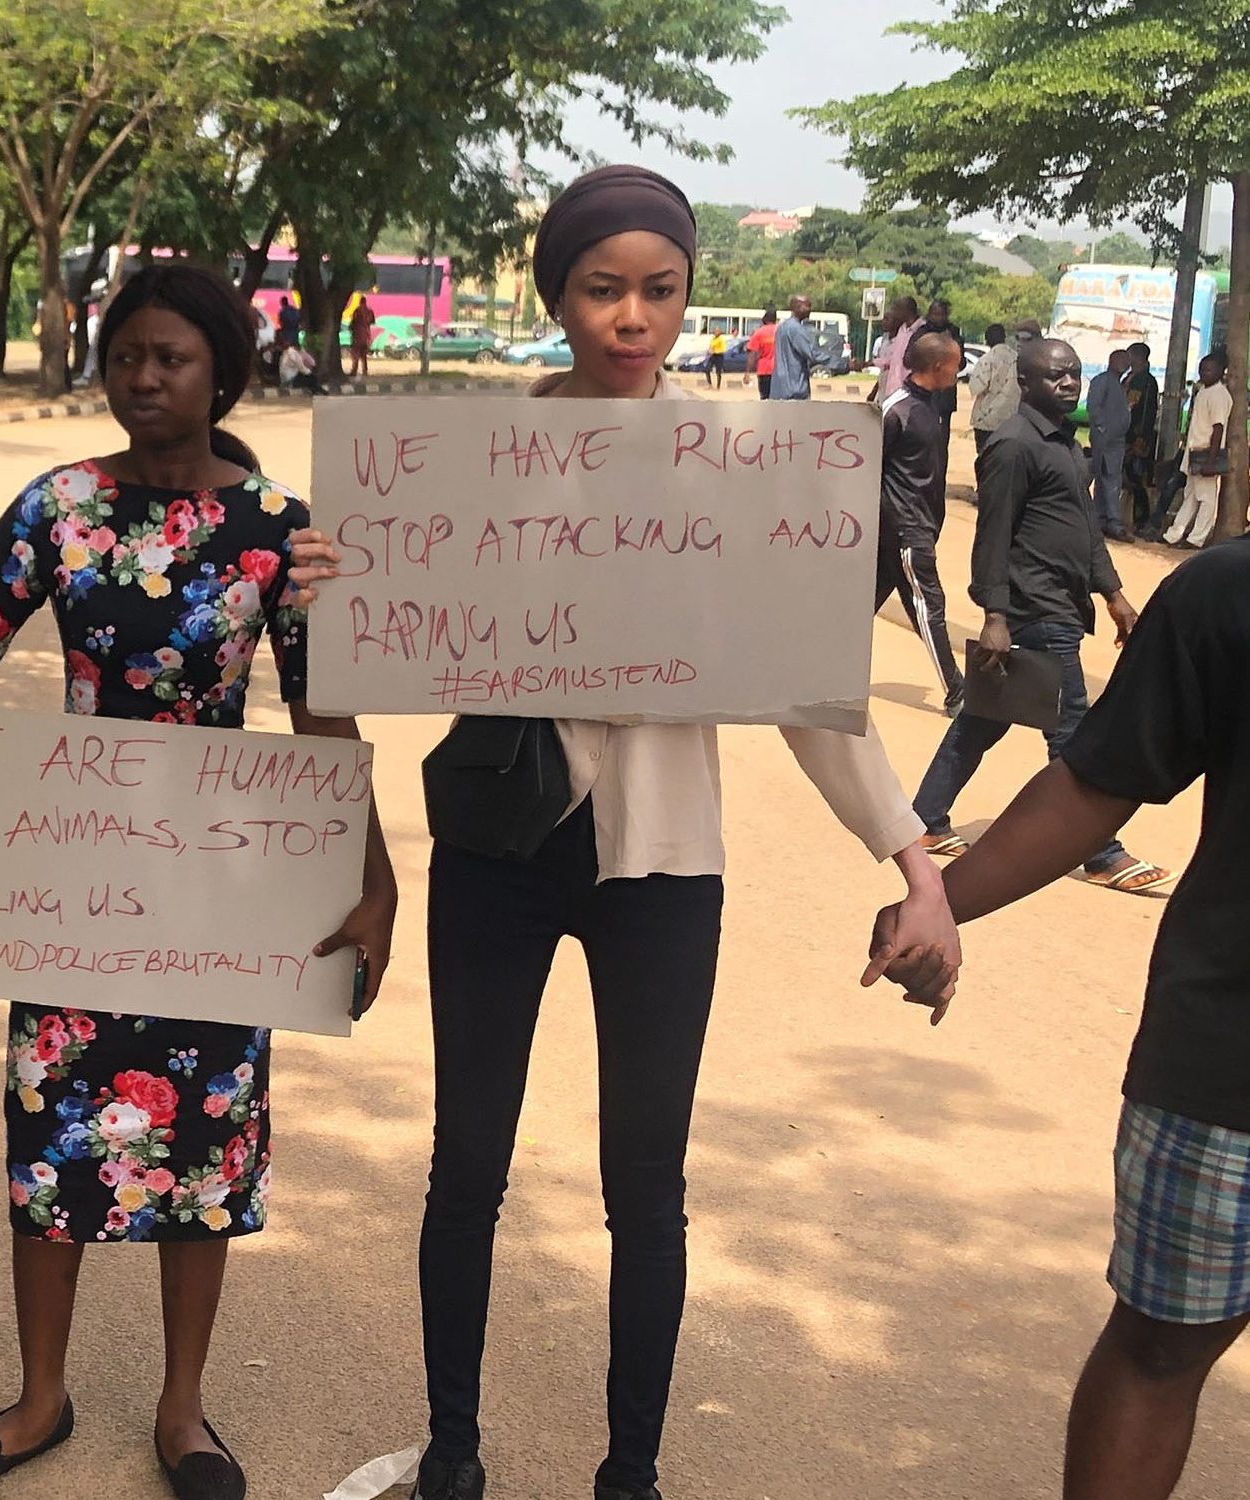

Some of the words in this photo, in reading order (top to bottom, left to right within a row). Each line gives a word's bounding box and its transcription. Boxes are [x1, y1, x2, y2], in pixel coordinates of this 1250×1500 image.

[353, 432, 439, 497] WE
[490, 424, 623, 478] HAVE
[673, 421, 865, 472] RIGHTS
[336, 513, 454, 578] STOP
[474, 511, 722, 567] ATTACKING
[768, 510, 864, 550] AND
[350, 596, 498, 664] RAPING
[525, 602, 578, 653] US
[429, 658, 698, 706] #SARSMUSTEND
[39, 734, 166, 787] ARE
[195, 744, 374, 804] HUMANS
[4, 806, 188, 857] ANIMALS,
[197, 819, 350, 856] STOP
